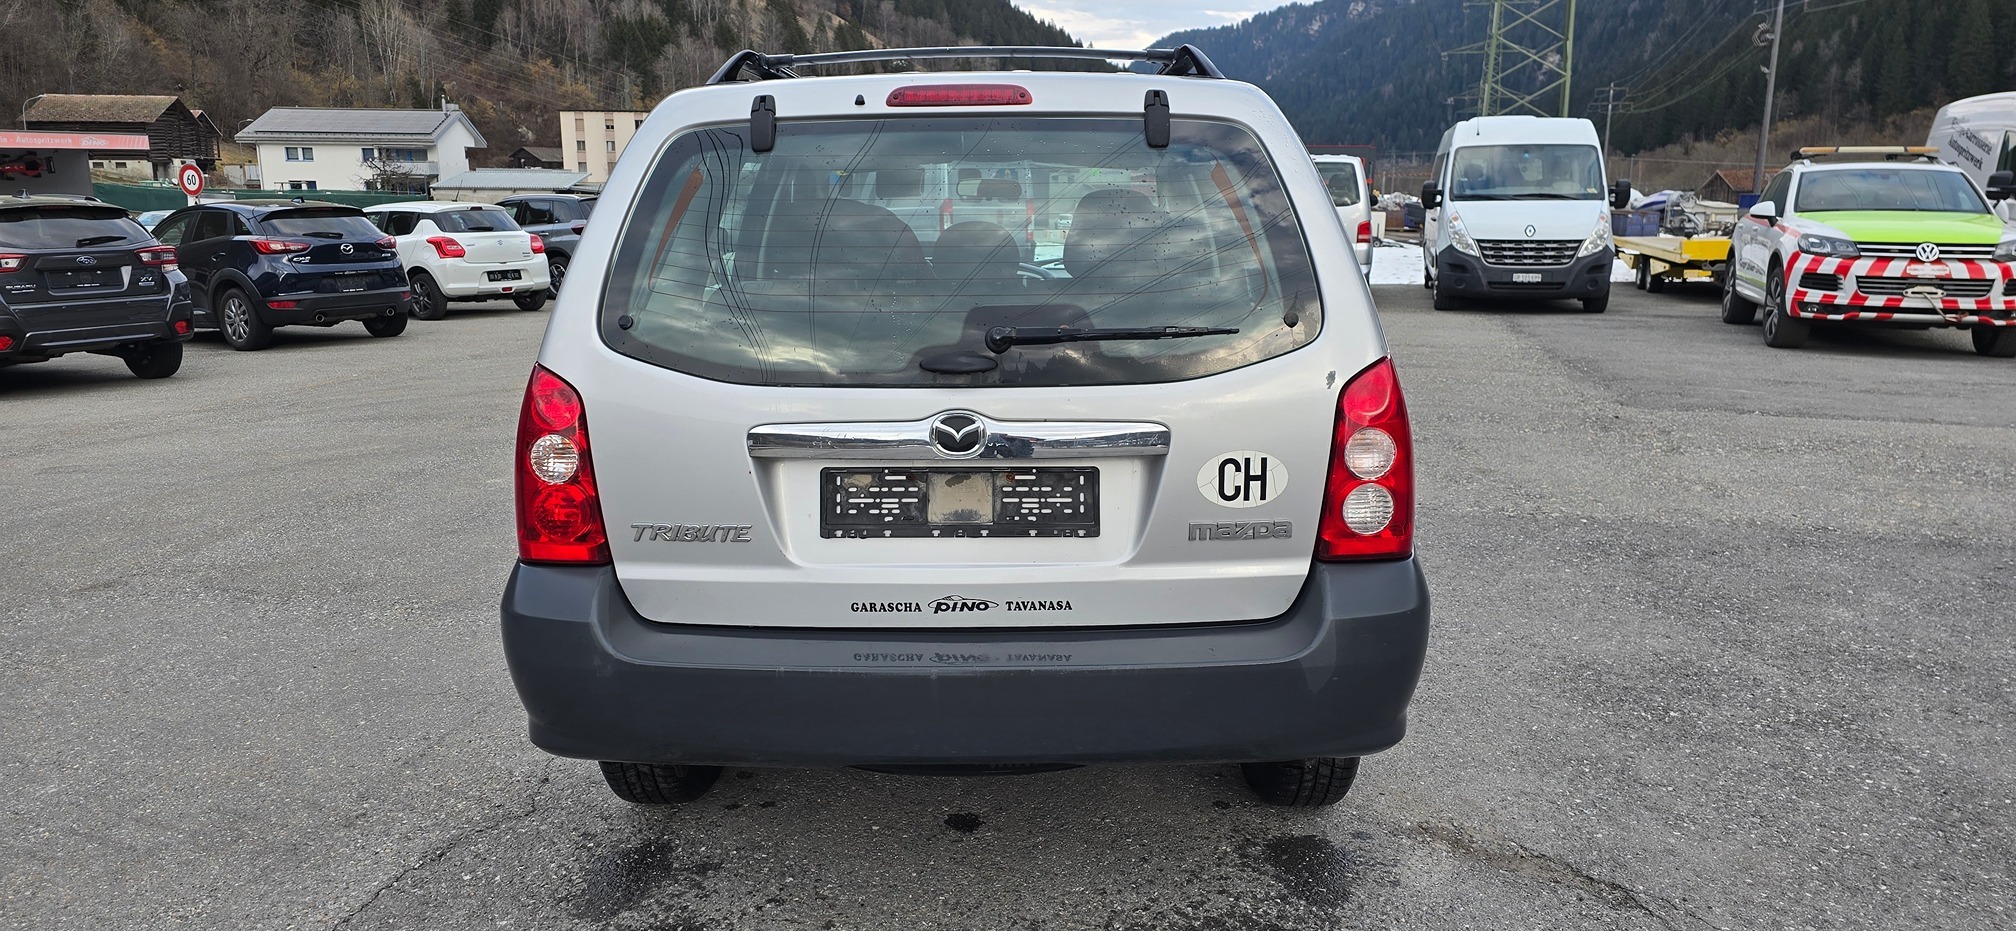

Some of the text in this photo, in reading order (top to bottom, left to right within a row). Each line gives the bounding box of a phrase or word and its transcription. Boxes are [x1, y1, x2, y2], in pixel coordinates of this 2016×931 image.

[187, 174, 197, 186] 60
[1217, 456, 1268, 503] CH
[630, 522, 753, 543] TRIBUTE
[850, 601, 923, 613] GARASCHA
[1005, 600, 1073, 612] TAVANASA
